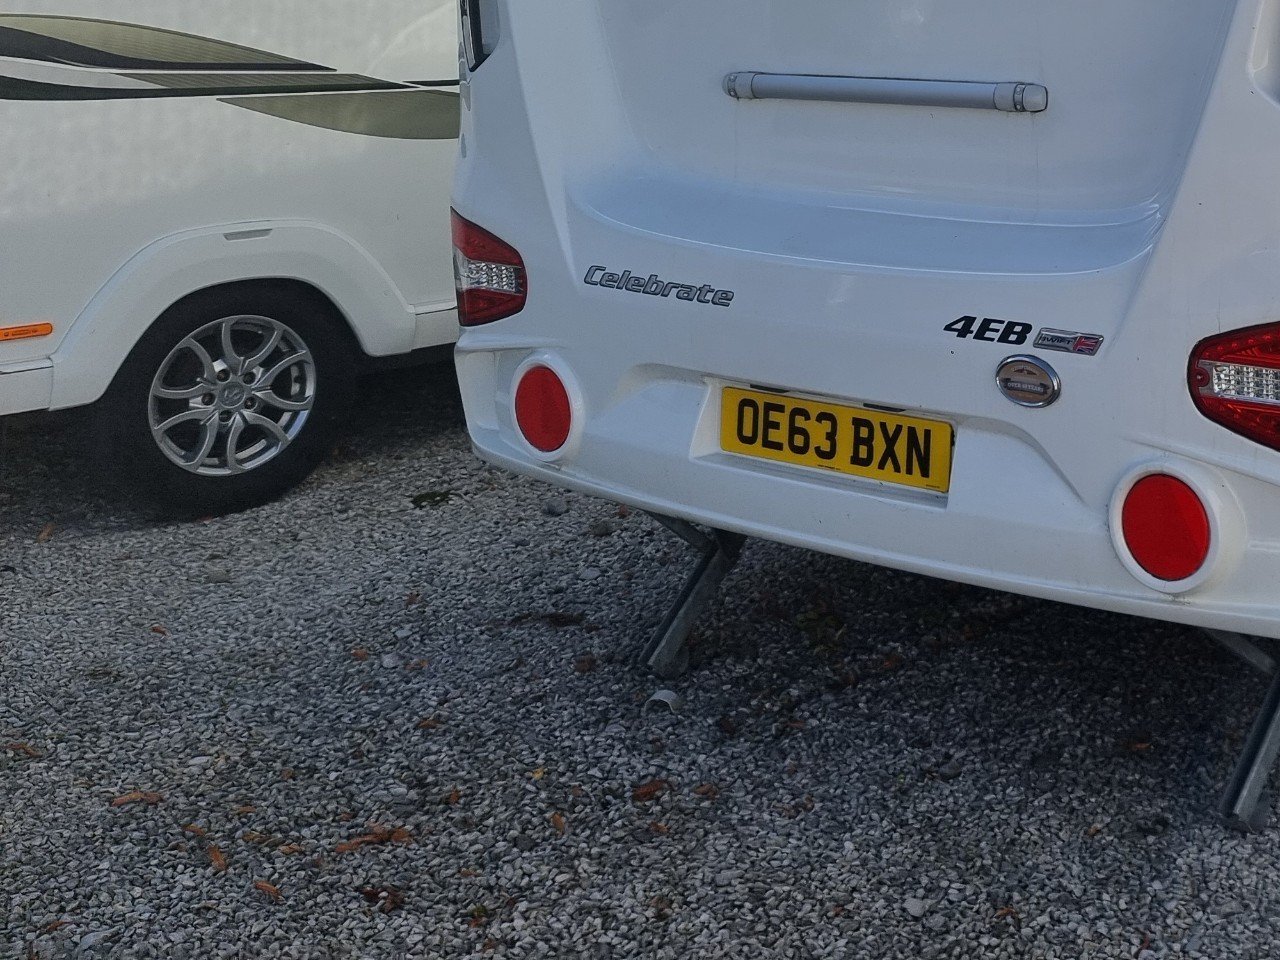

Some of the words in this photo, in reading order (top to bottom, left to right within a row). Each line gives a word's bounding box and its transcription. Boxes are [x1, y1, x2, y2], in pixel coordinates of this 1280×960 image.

[583, 264, 735, 307] Celebrate
[943, 315, 1033, 345] 4EB
[1040, 336, 1074, 345] SWIFT
[736, 397, 838, 460] OE63
[849, 416, 932, 478] BXN
